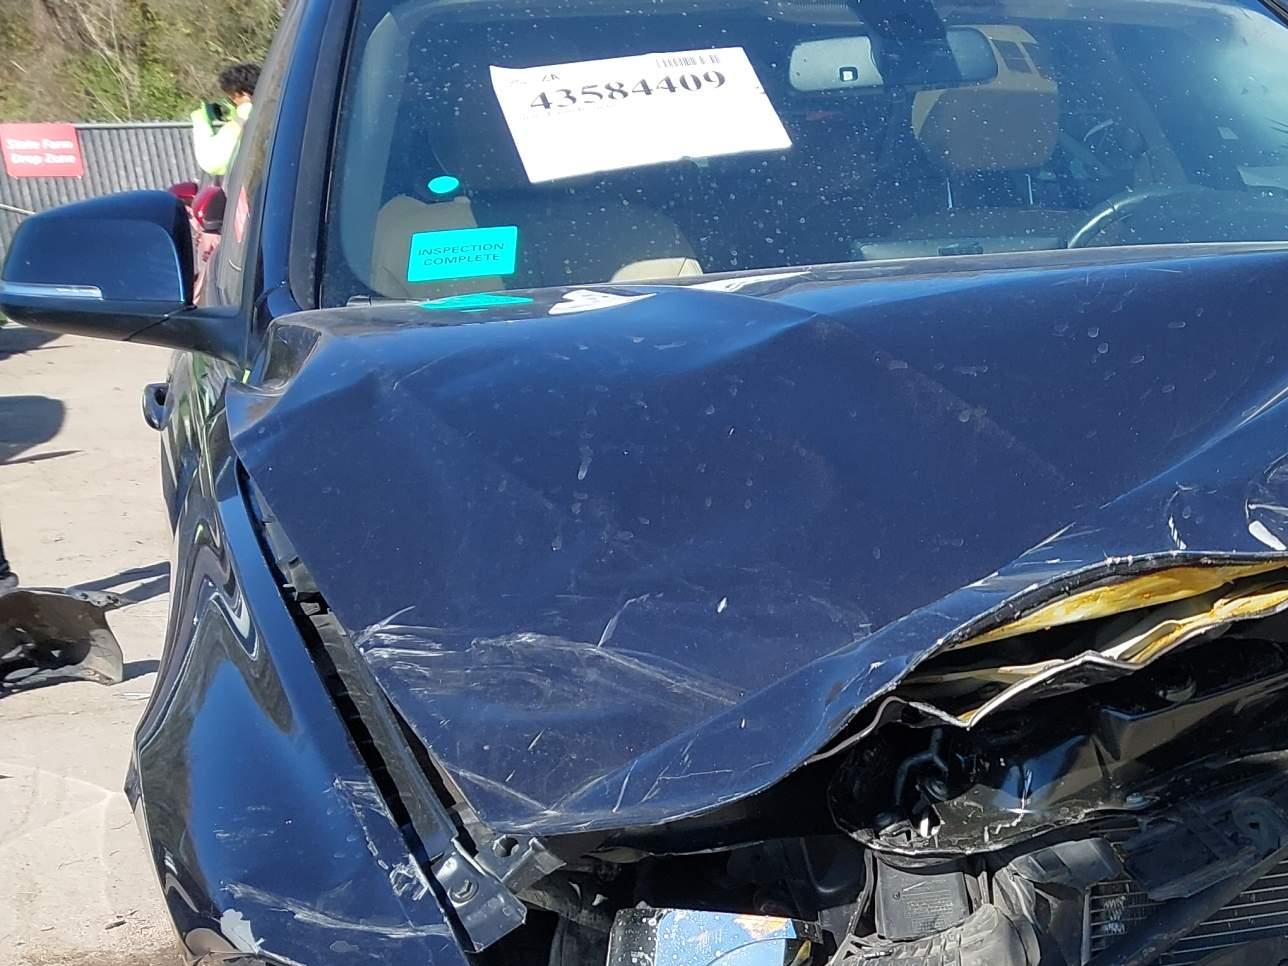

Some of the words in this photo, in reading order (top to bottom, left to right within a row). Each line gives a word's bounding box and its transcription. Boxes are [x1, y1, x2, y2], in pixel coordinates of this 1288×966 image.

[529, 70, 726, 110] 43584409
[418, 243, 504, 256] INSPECTION
[424, 253, 500, 266] COMPLETE
